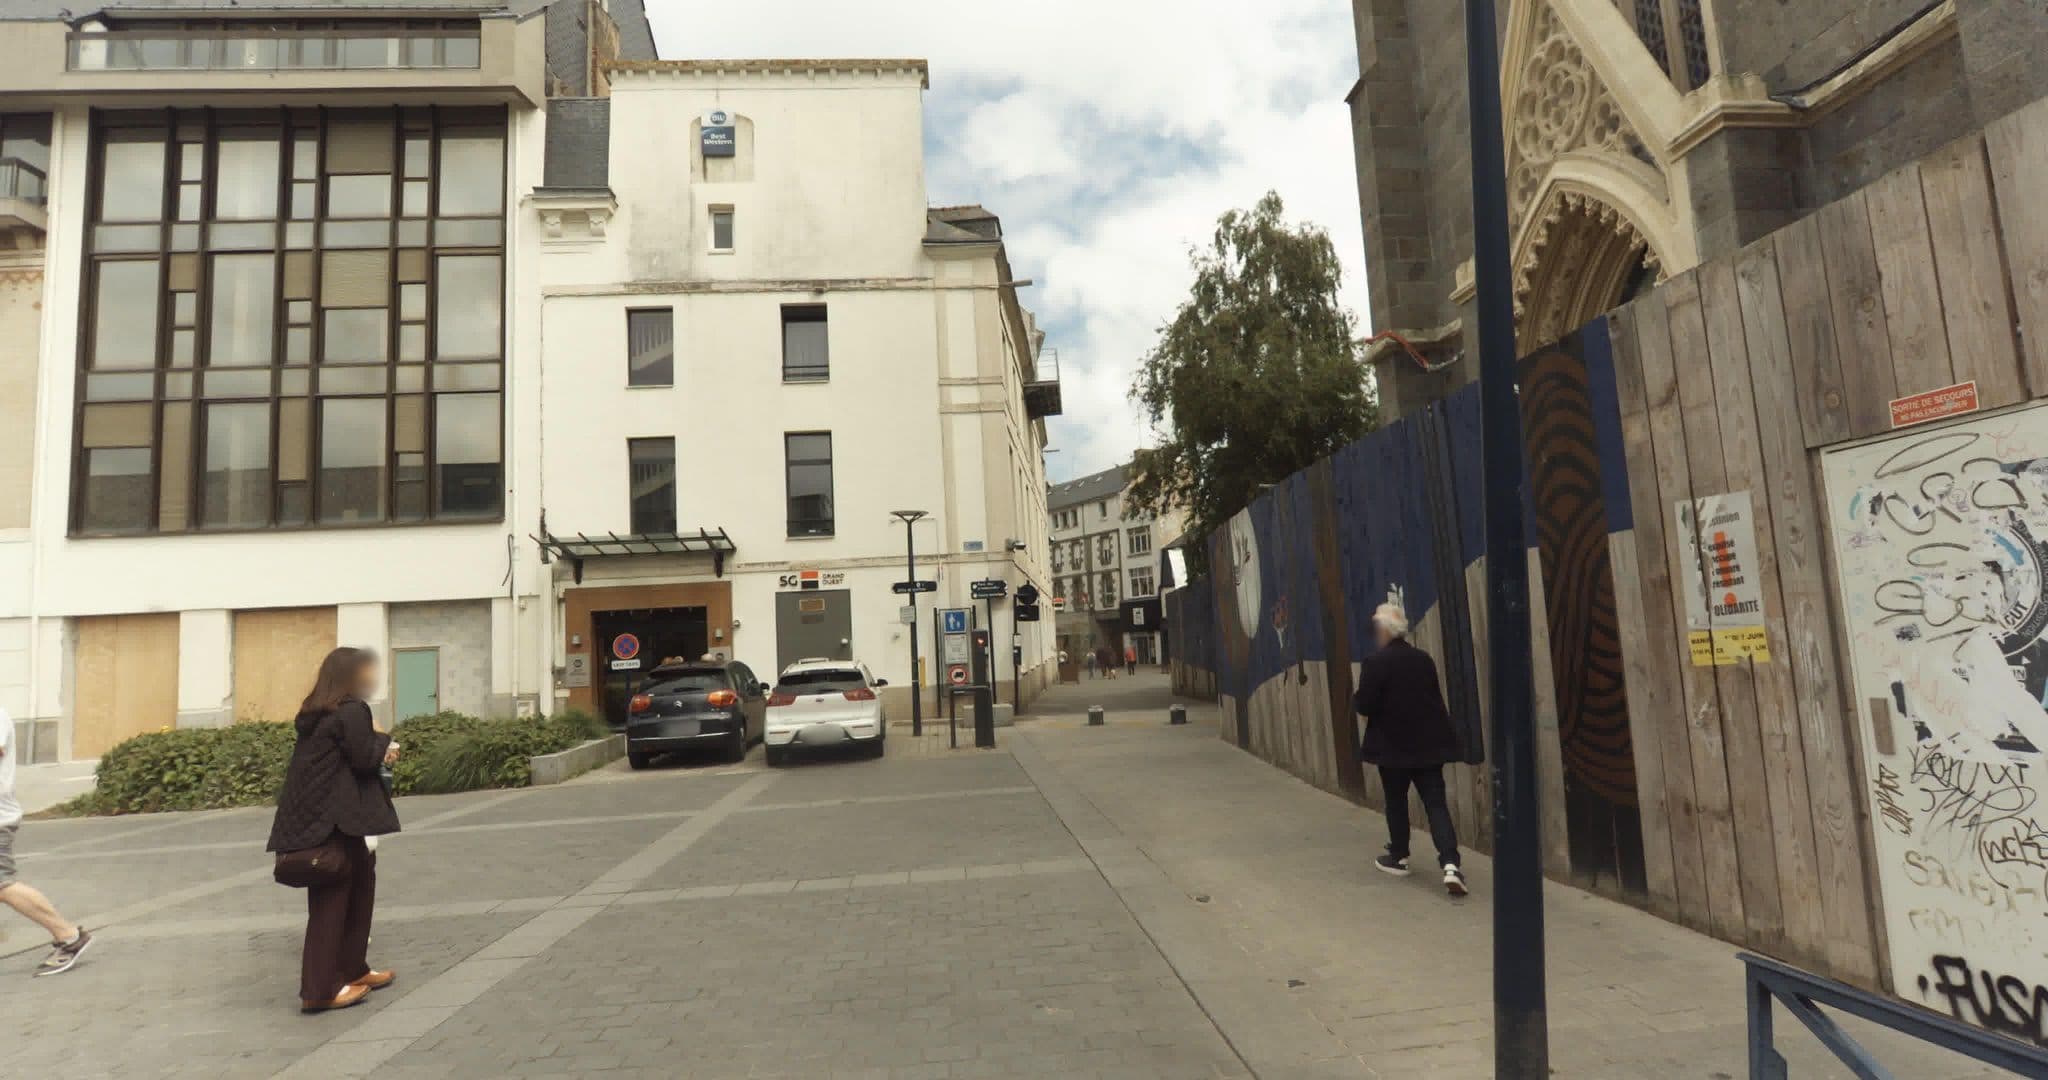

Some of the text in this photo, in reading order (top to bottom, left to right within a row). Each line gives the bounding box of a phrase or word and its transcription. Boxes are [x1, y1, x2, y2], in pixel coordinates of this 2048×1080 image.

[1892, 387, 1974, 413] SORTIE DE SECOURS
[779, 575, 798, 587] SG
